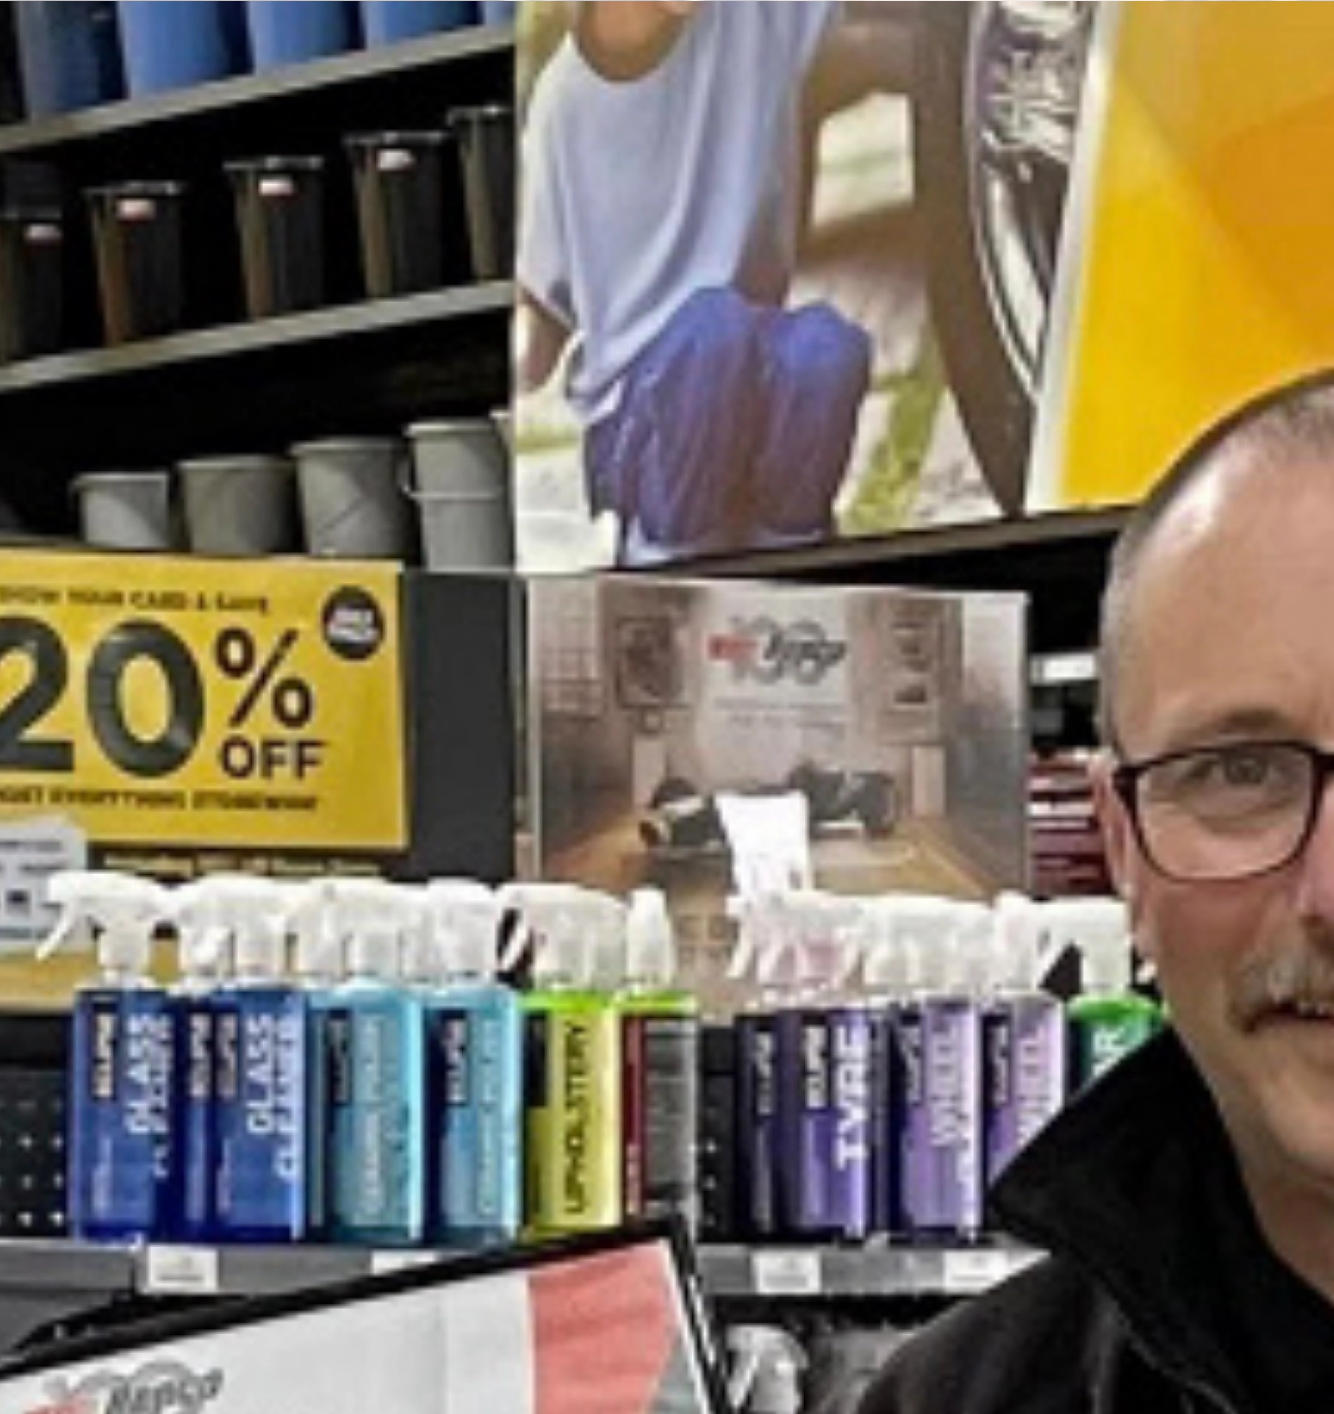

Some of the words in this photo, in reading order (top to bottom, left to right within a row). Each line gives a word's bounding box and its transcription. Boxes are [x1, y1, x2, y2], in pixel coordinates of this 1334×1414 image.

[221, 734, 328, 780] OFF
[245, 1013, 274, 1136] GLASS
[836, 1024, 869, 1169] TYRE
